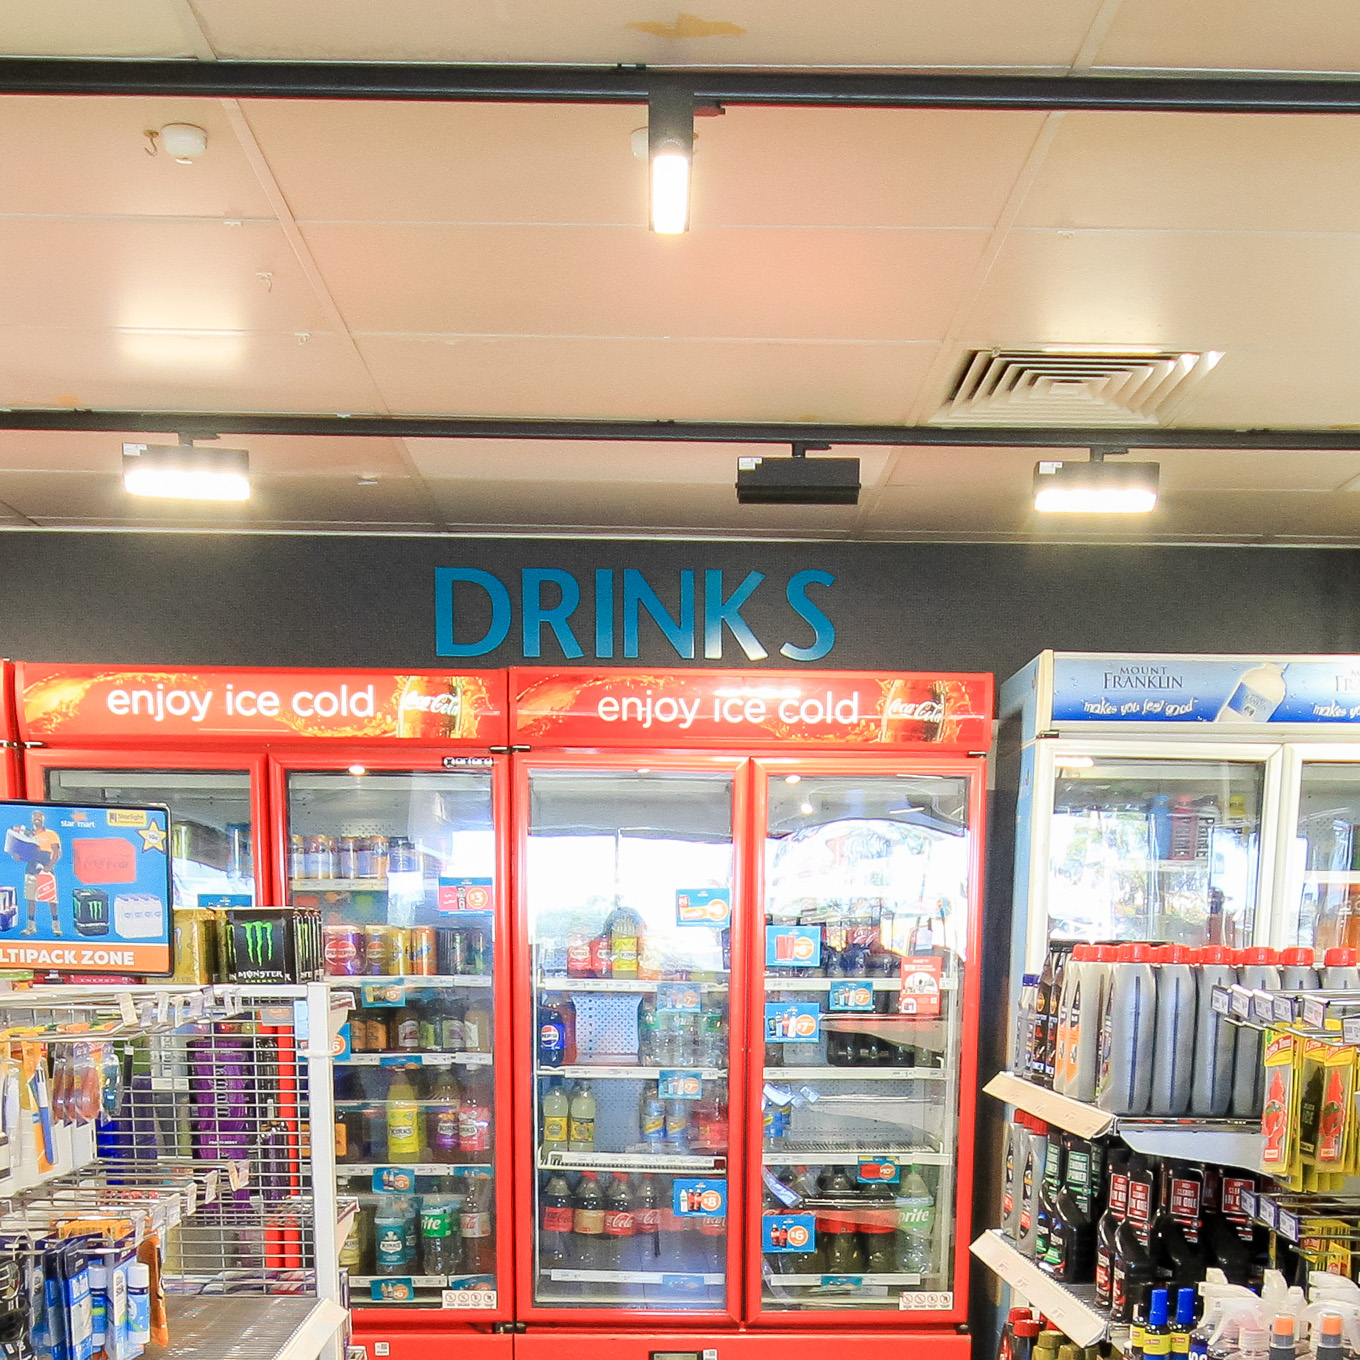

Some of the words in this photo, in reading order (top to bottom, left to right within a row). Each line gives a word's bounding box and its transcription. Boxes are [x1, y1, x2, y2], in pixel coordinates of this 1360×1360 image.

[435, 567, 836, 661] DRINKS
[1119, 666, 1167, 675] MOUNT
[1103, 671, 1183, 689] FRANKLIN
[107, 685, 213, 721] enjoy
[226, 685, 279, 716] ice
[292, 685, 374, 717] cold
[598, 690, 700, 728] enjoy
[714, 692, 766, 724] ice
[778, 692, 859, 725] cold
[888, 698, 943, 723] Coca-Cola
[1082, 699, 1119, 715] makes
[1120, 700, 1140, 715] you
[1312, 702, 1347, 716] makes
[81, 949, 134, 966] ZONE
[238, 970, 285, 978] MONSTER
[391, 1127, 412, 1135] KIRKS
[791, 1231, 805, 1240] $6
